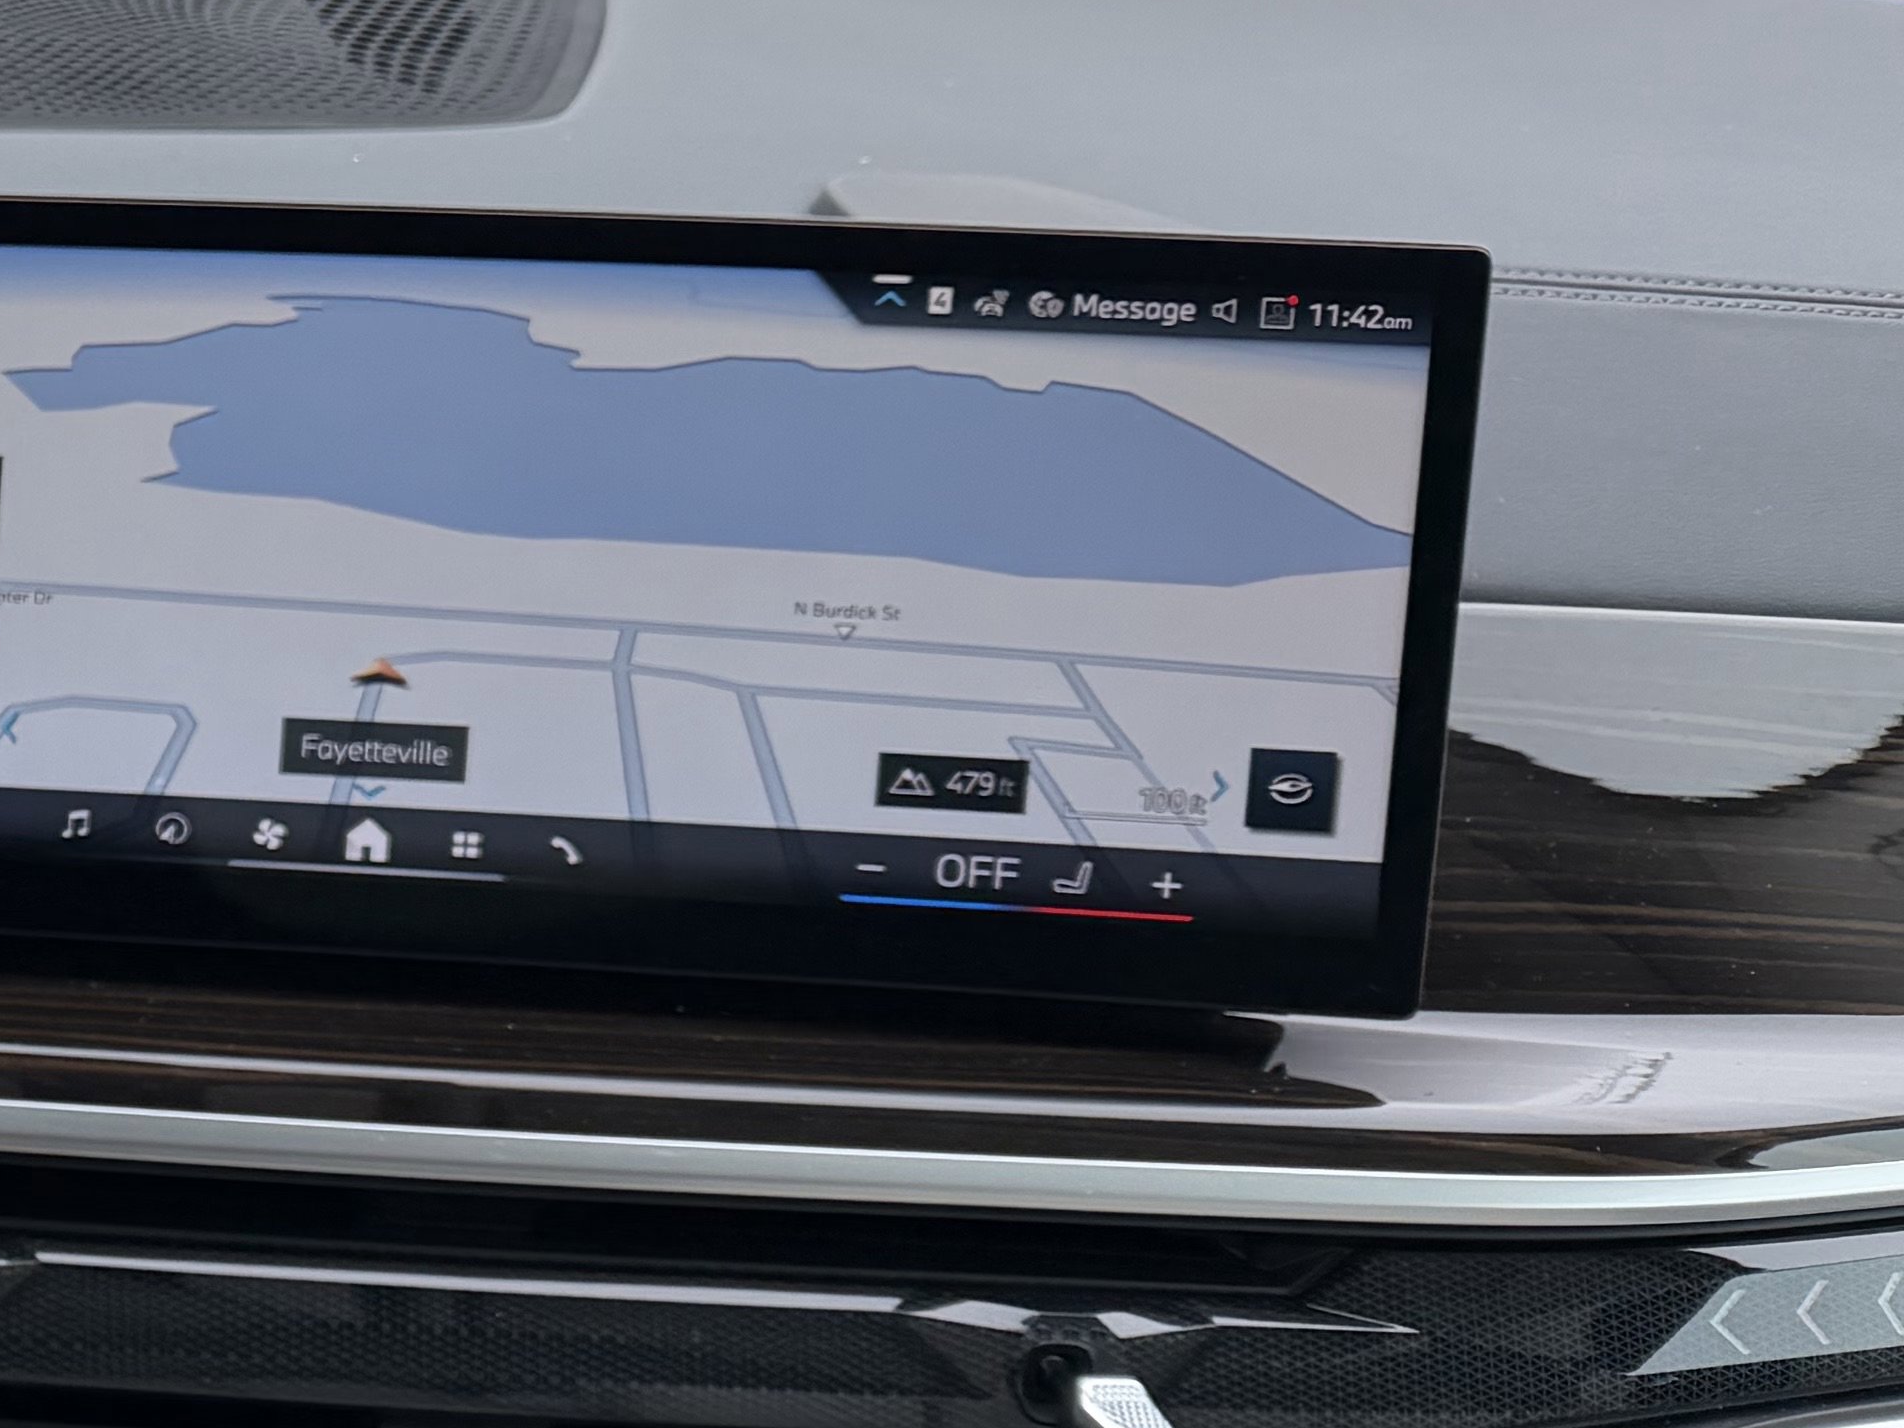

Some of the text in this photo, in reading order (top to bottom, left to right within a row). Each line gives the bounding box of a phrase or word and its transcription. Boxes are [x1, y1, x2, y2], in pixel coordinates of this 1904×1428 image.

[1072, 294, 1197, 327] Message
[794, 602, 901, 621] N Burdick St
[300, 733, 450, 766] Fayetteville
[945, 771, 995, 795] 479
[935, 853, 1022, 890] OFF
